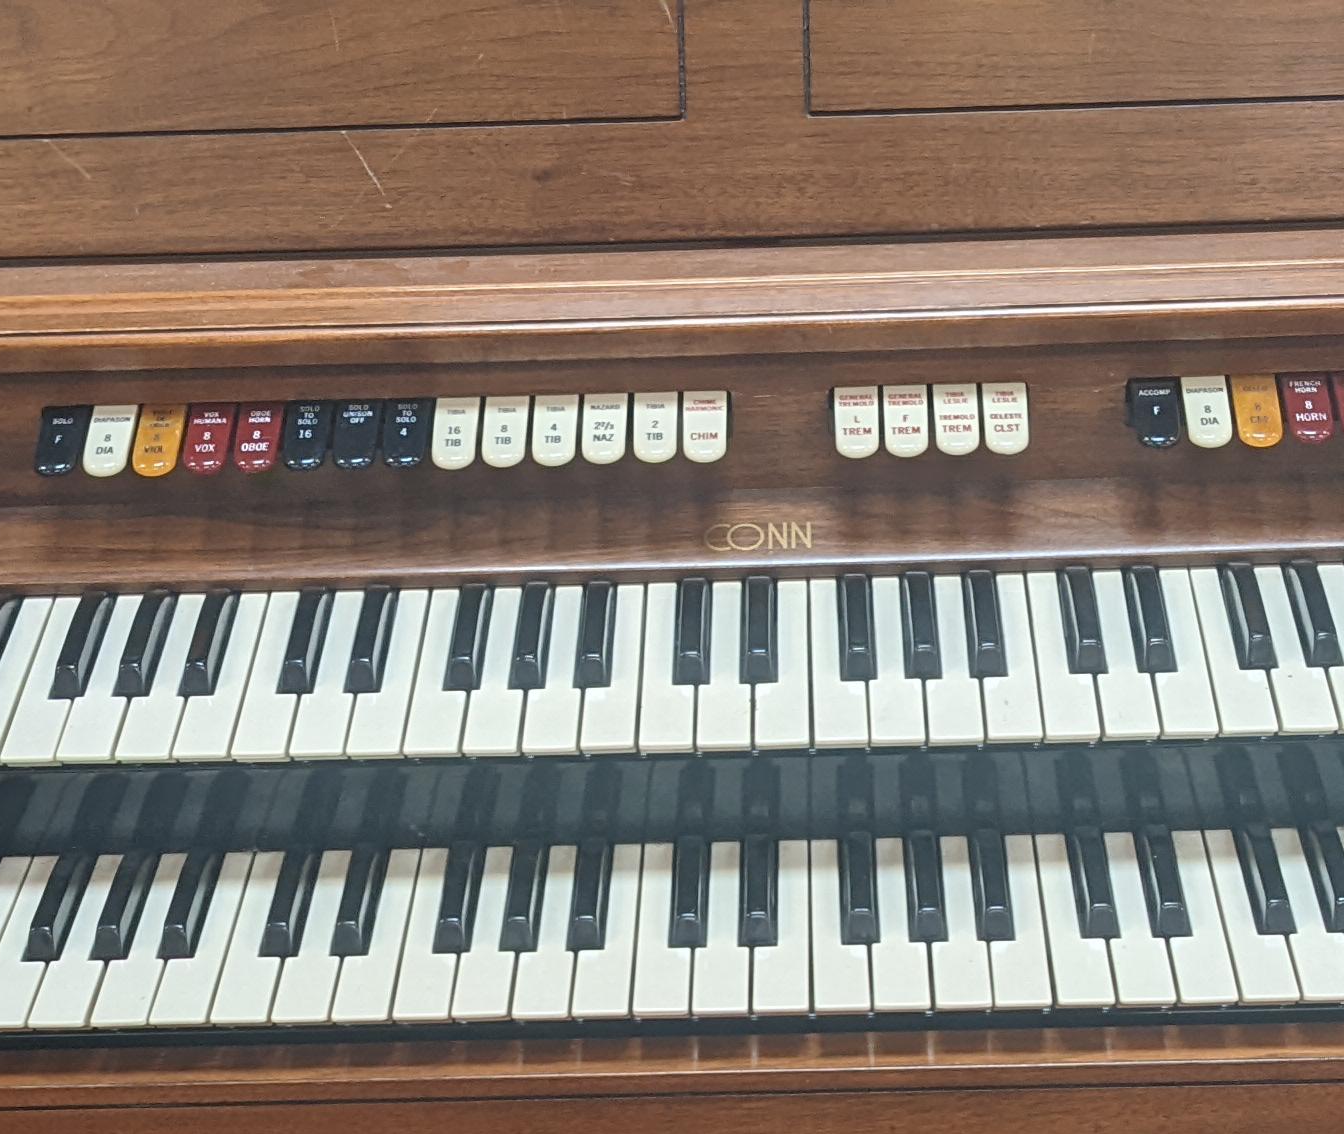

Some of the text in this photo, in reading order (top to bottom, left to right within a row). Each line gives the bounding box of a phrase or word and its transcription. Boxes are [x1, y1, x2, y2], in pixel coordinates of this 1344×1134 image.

[1138, 389, 1171, 397] ACCOMP
[1204, 405, 1212, 413] 8
[1304, 400, 1313, 409] 8
[1153, 405, 1160, 415] F
[854, 415, 861, 423] L
[902, 414, 909, 423] F
[1200, 417, 1219, 426] DIA
[1296, 413, 1327, 422] HORN
[500, 424, 508, 432] 8
[550, 423, 557, 431] 4
[651, 420, 659, 429] 2
[942, 424, 973, 433] TREM
[994, 423, 1021, 432] CLST
[252, 430, 261, 439] 8
[298, 429, 312, 439] 16
[399, 427, 407, 436] 4
[447, 426, 461, 435] 16
[842, 427, 872, 436] TREM
[891, 426, 921, 435] TREM
[54, 435, 63, 444] F
[104, 433, 111, 442] 8
[202, 431, 211, 440] 8
[544, 435, 562, 444] TIB
[592, 433, 614, 442] NAZ
[646, 432, 663, 441] TIB
[690, 432, 718, 441] CHIM
[444, 438, 461, 447] TIB
[494, 436, 512, 445] TIB
[95, 446, 113, 455] DIA
[194, 443, 215, 453] VOX
[241, 442, 269, 452] OBOE
[704, 522, 812, 551] CONN
